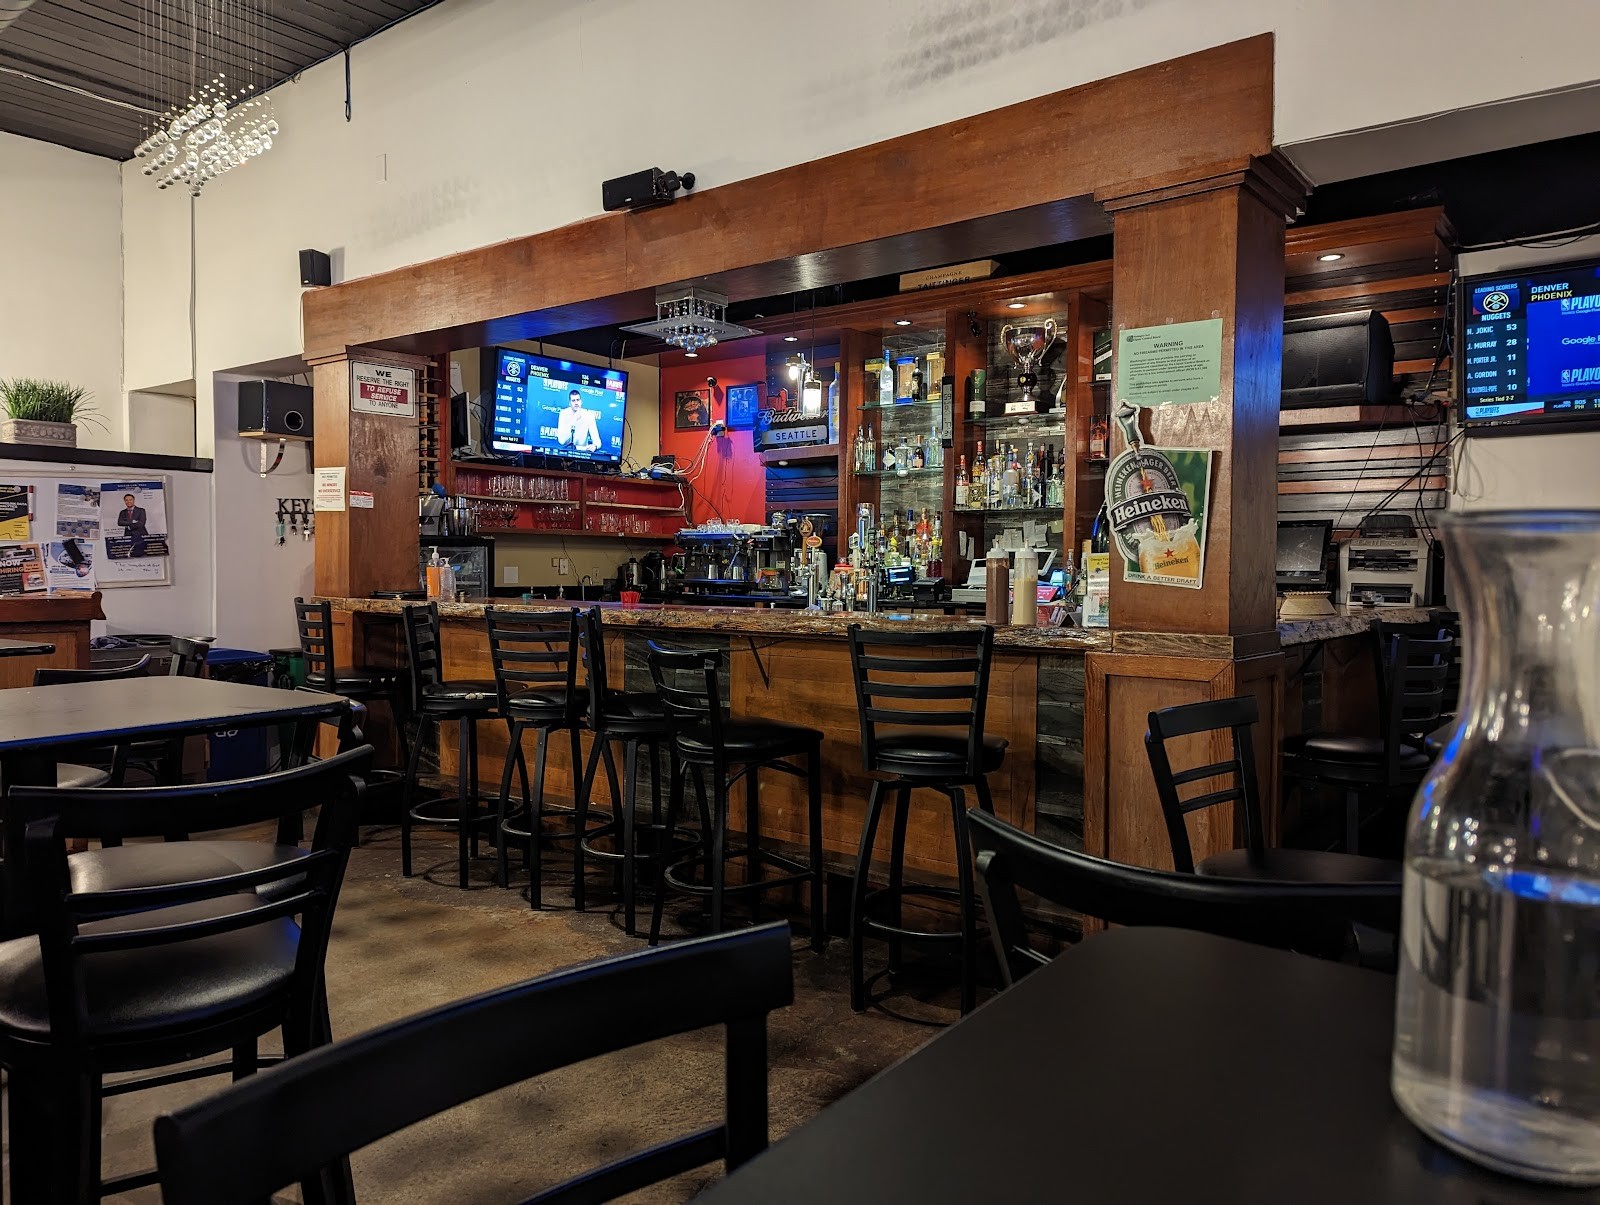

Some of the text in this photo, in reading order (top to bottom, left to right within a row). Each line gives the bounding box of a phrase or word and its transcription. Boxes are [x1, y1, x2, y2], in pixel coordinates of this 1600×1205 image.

[926, 271, 962, 280] CHAMPAGNE
[1531, 283, 1569, 294] DENVER
[1531, 290, 1573, 301] PHOENIX
[1482, 312, 1511, 321] NUGGETS
[1476, 326, 1494, 334] JOKIC
[1474, 341, 1497, 349] MURRAY
[1562, 336, 1595, 345] Google
[356, 375, 380, 384] RESERVE
[377, 386, 402, 395] REFUSE
[371, 393, 397, 401] SERVICE
[758, 408, 829, 425] Budwr
[776, 430, 817, 440] SEATTLE
[1115, 462, 1138, 498] HEINEKEN
[1164, 467, 1176, 486] BEER
[1114, 494, 1188, 524] Heineken
[1154, 556, 1189, 570] Heineken
